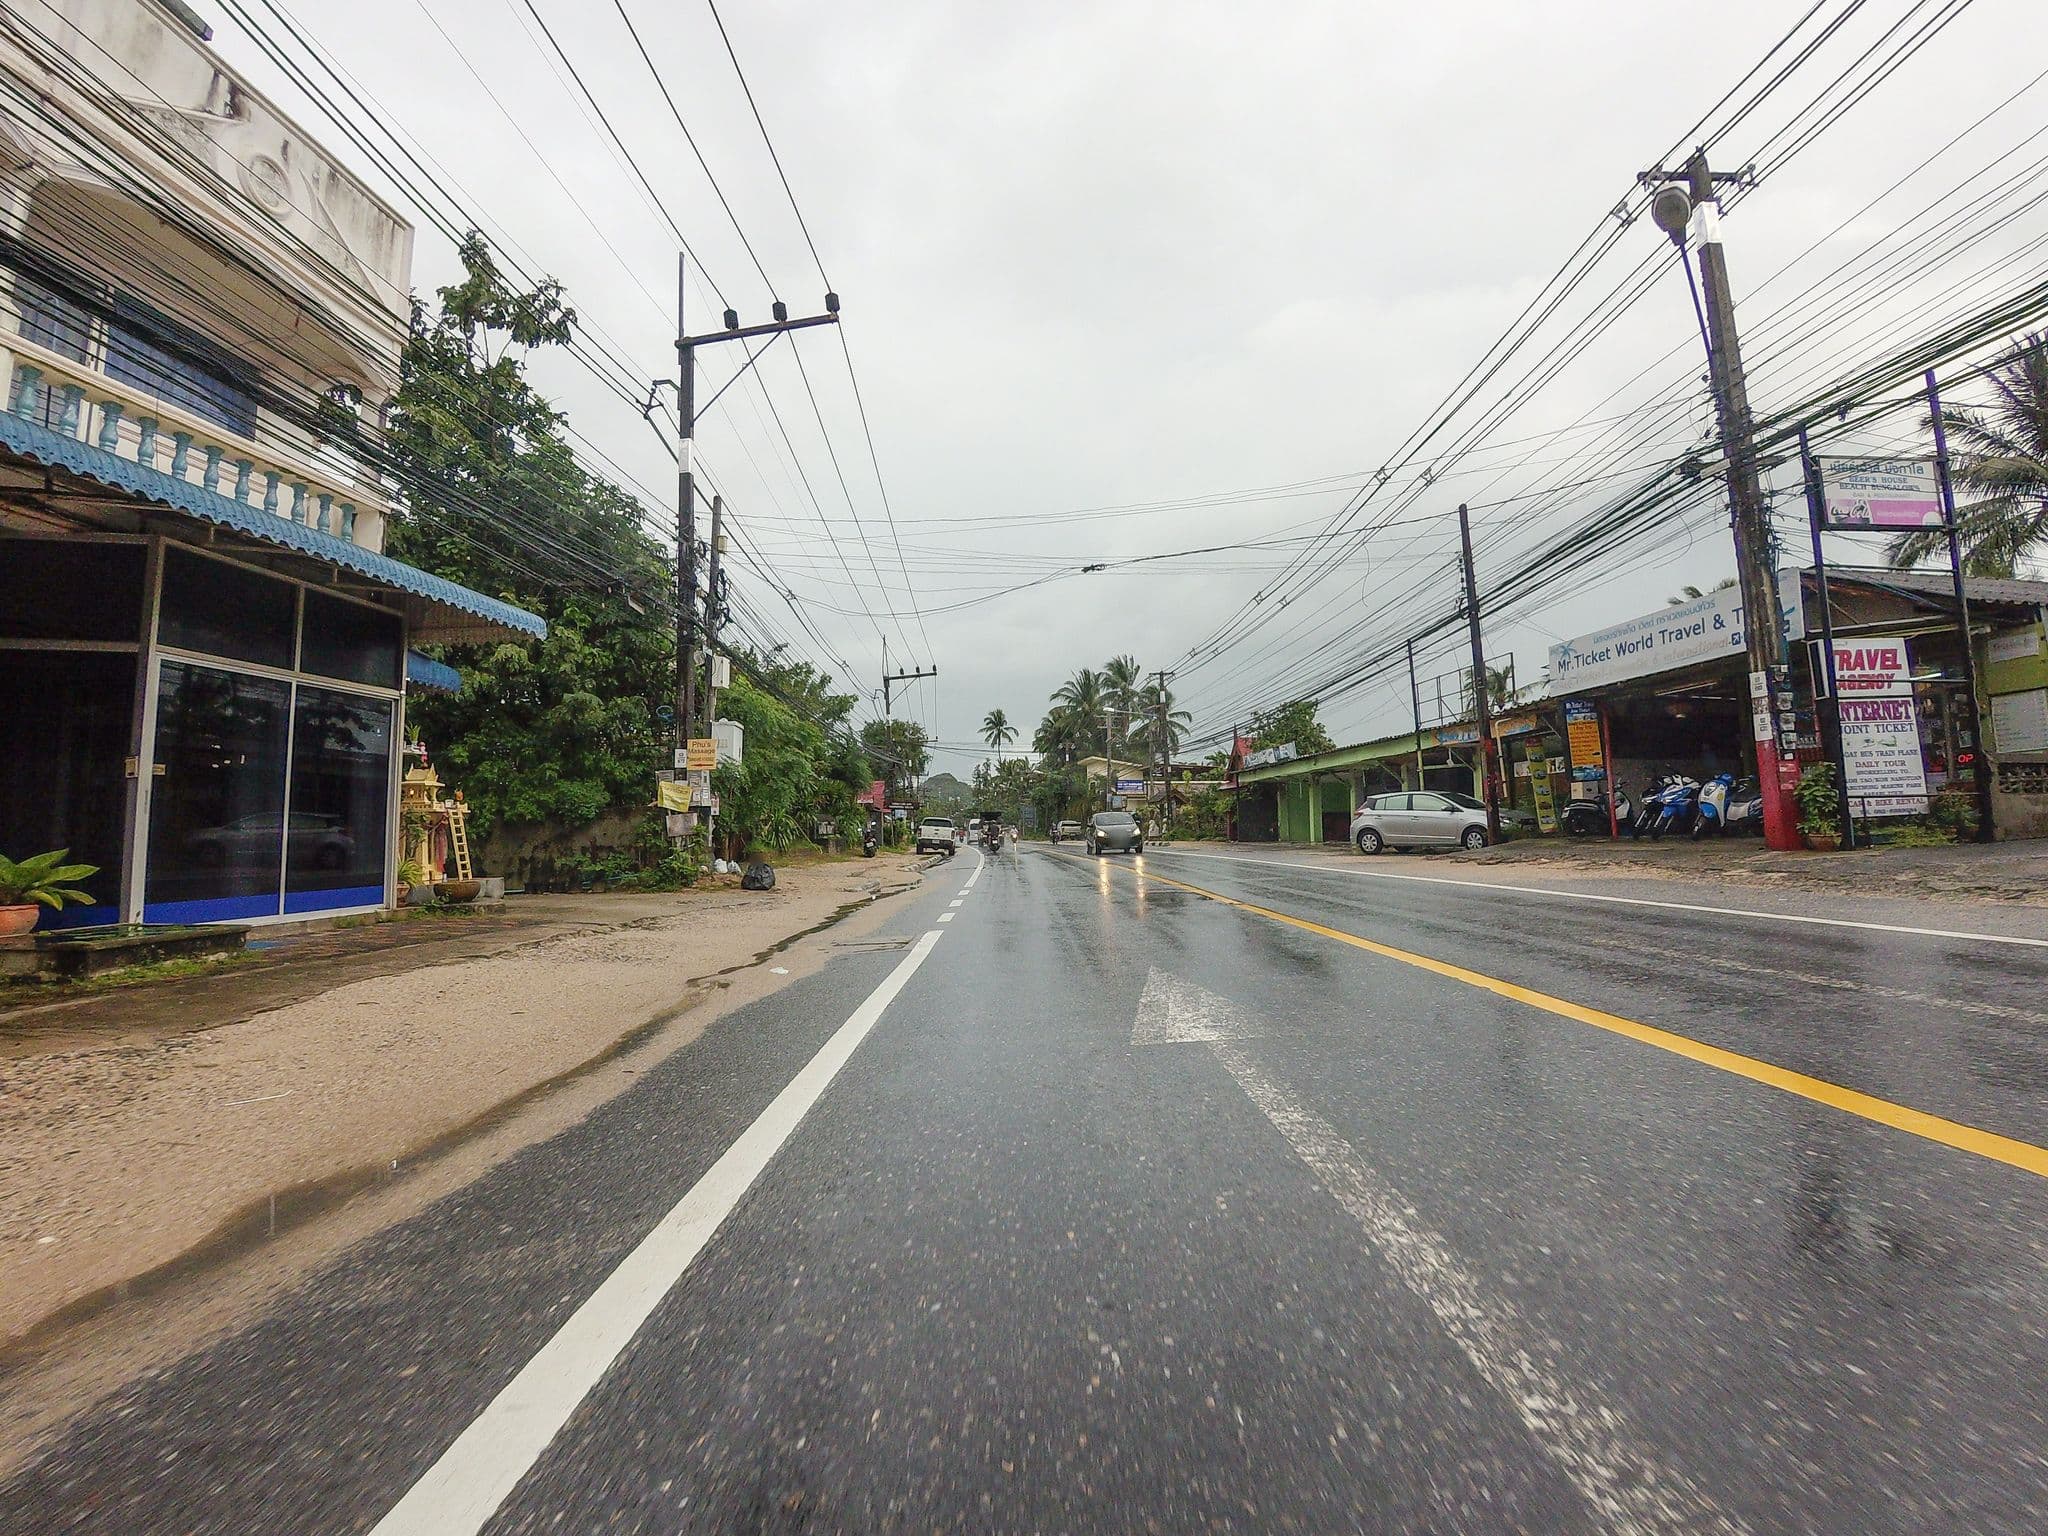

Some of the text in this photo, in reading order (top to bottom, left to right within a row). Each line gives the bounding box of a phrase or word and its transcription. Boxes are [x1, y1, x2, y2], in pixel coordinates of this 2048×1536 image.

[1557, 646, 1612, 674] Mr.Ticket
[1615, 632, 1654, 658] World
[1658, 617, 1706, 645] Travel
[1713, 613, 1727, 630] &
[1839, 700, 1912, 722] NTERNET
[1874, 722, 1915, 734] TICKET
[1855, 760, 1907, 768] DAILY TOUR
[1875, 799, 1894, 807] BIKE
[1896, 797, 1926, 805] RENTAL
